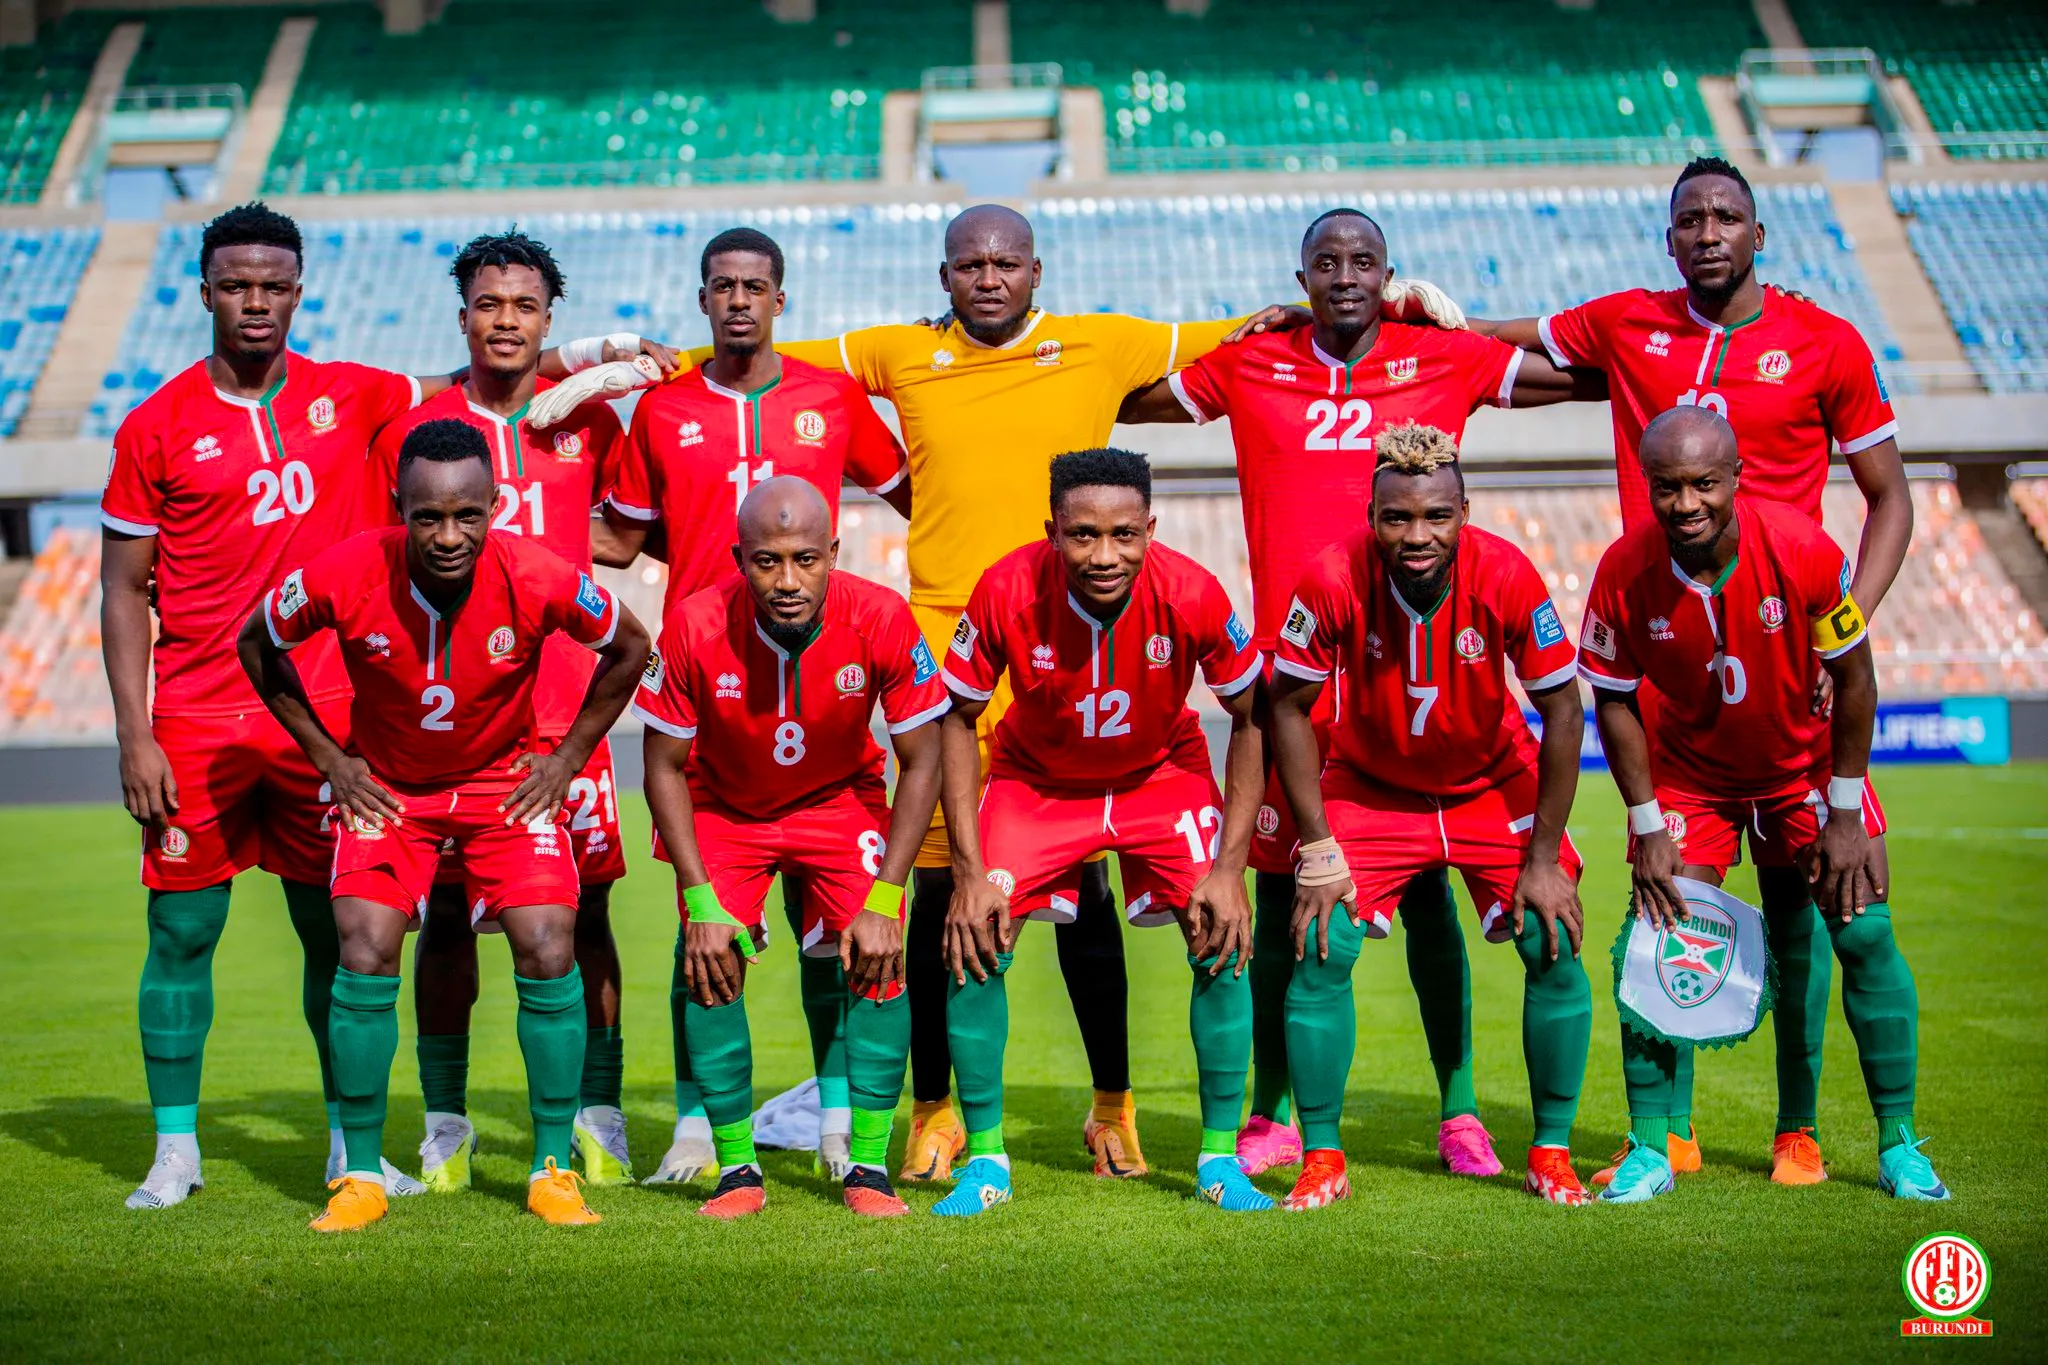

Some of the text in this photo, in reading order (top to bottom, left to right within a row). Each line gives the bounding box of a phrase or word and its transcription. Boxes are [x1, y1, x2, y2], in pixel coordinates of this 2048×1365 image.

[1644, 344, 1669, 357] errea
[1273, 373, 1297, 382] errea
[680, 434, 704, 448] errea
[1305, 399, 1373, 451] 22
[195, 447, 222, 462] errea
[247, 460, 315, 526] 20
[491, 481, 545, 536] 21
[1649, 630, 1675, 641] errea
[1830, 604, 1860, 641] C
[1032, 658, 1055, 670] errea
[1705, 651, 1747, 704] 10
[420, 685, 455, 731] 2
[715, 689, 742, 699] errea
[1075, 689, 1131, 738] 12
[1407, 683, 1439, 736] 7
[773, 721, 806, 766] 8
[568, 769, 615, 832] 21
[534, 846, 560, 857] errea
[586, 842, 609, 855] errea
[858, 830, 887, 876] 8
[1174, 806, 1224, 864] 12
[1674, 912, 1732, 940] URUNDI
